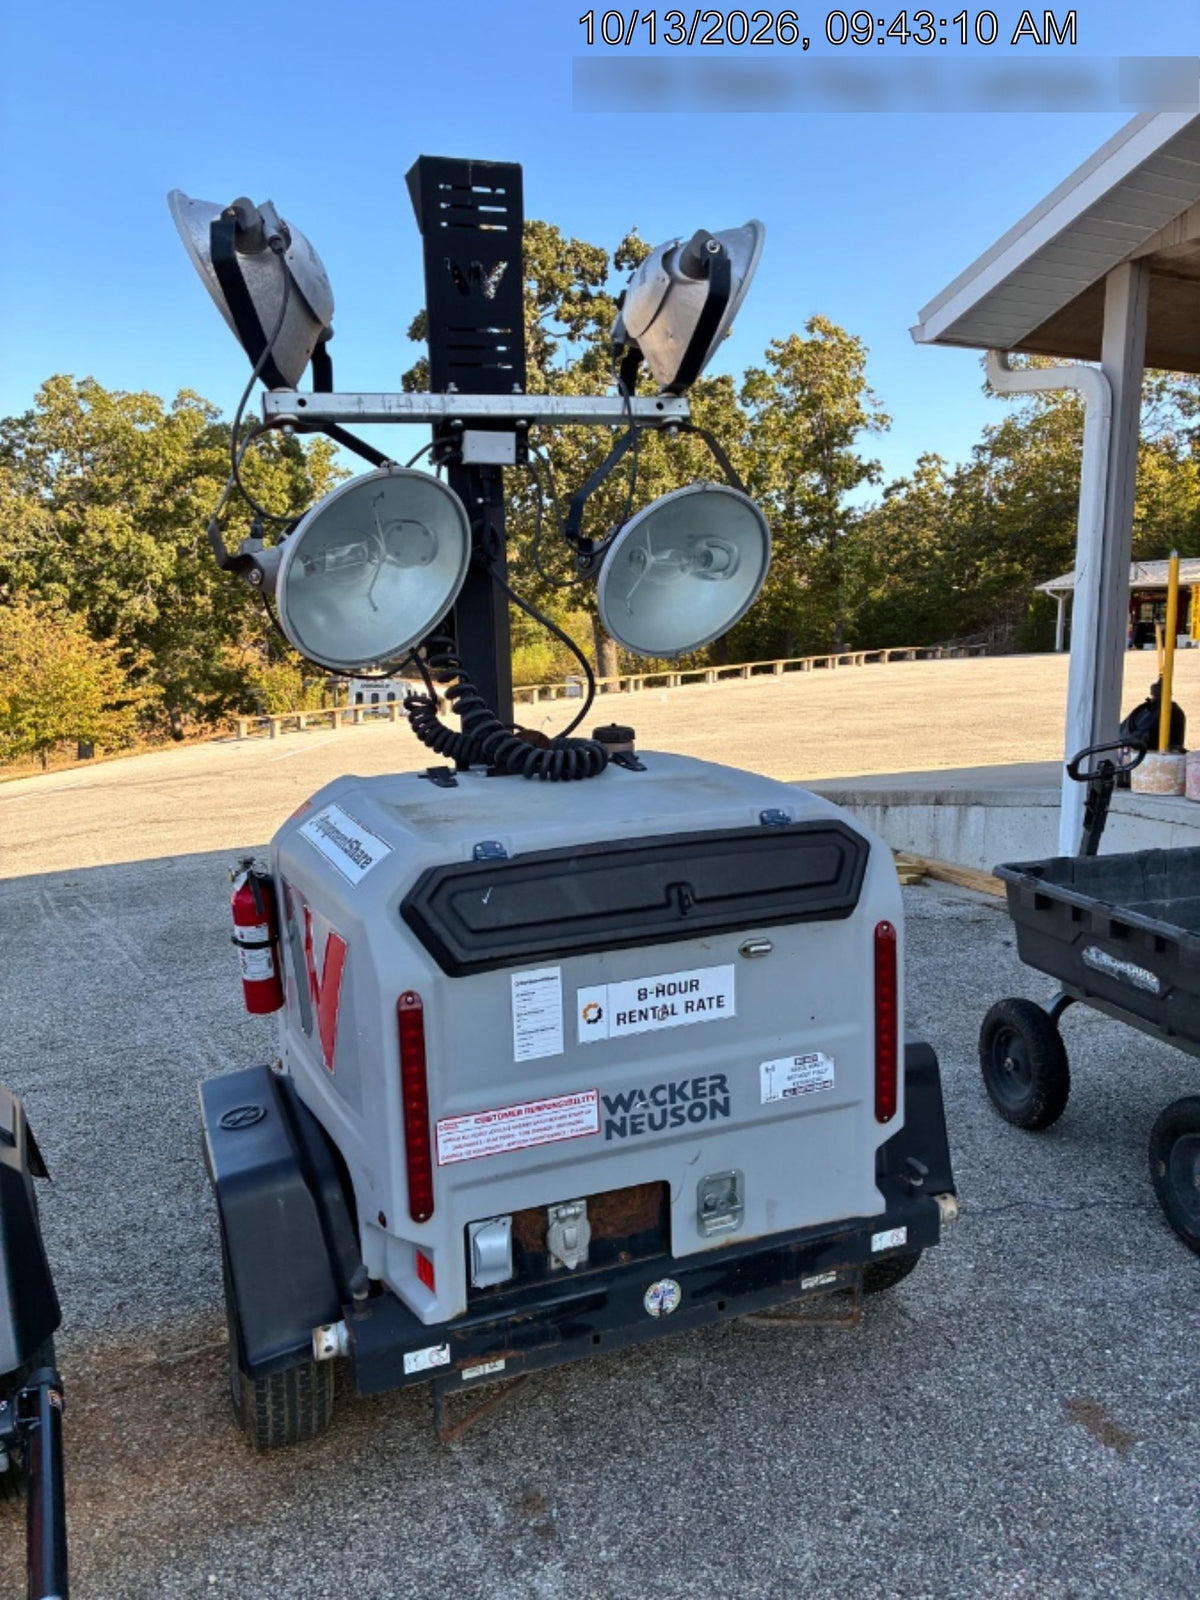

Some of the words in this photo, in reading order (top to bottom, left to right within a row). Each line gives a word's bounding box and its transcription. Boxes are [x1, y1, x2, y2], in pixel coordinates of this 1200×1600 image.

[637, 979, 700, 1001] 8-HOUR
[616, 1004, 678, 1026] RENTAL
[684, 995, 725, 1014] RATE
[601, 1073, 731, 1116] WACKER
[605, 1096, 731, 1141] NEUSON
